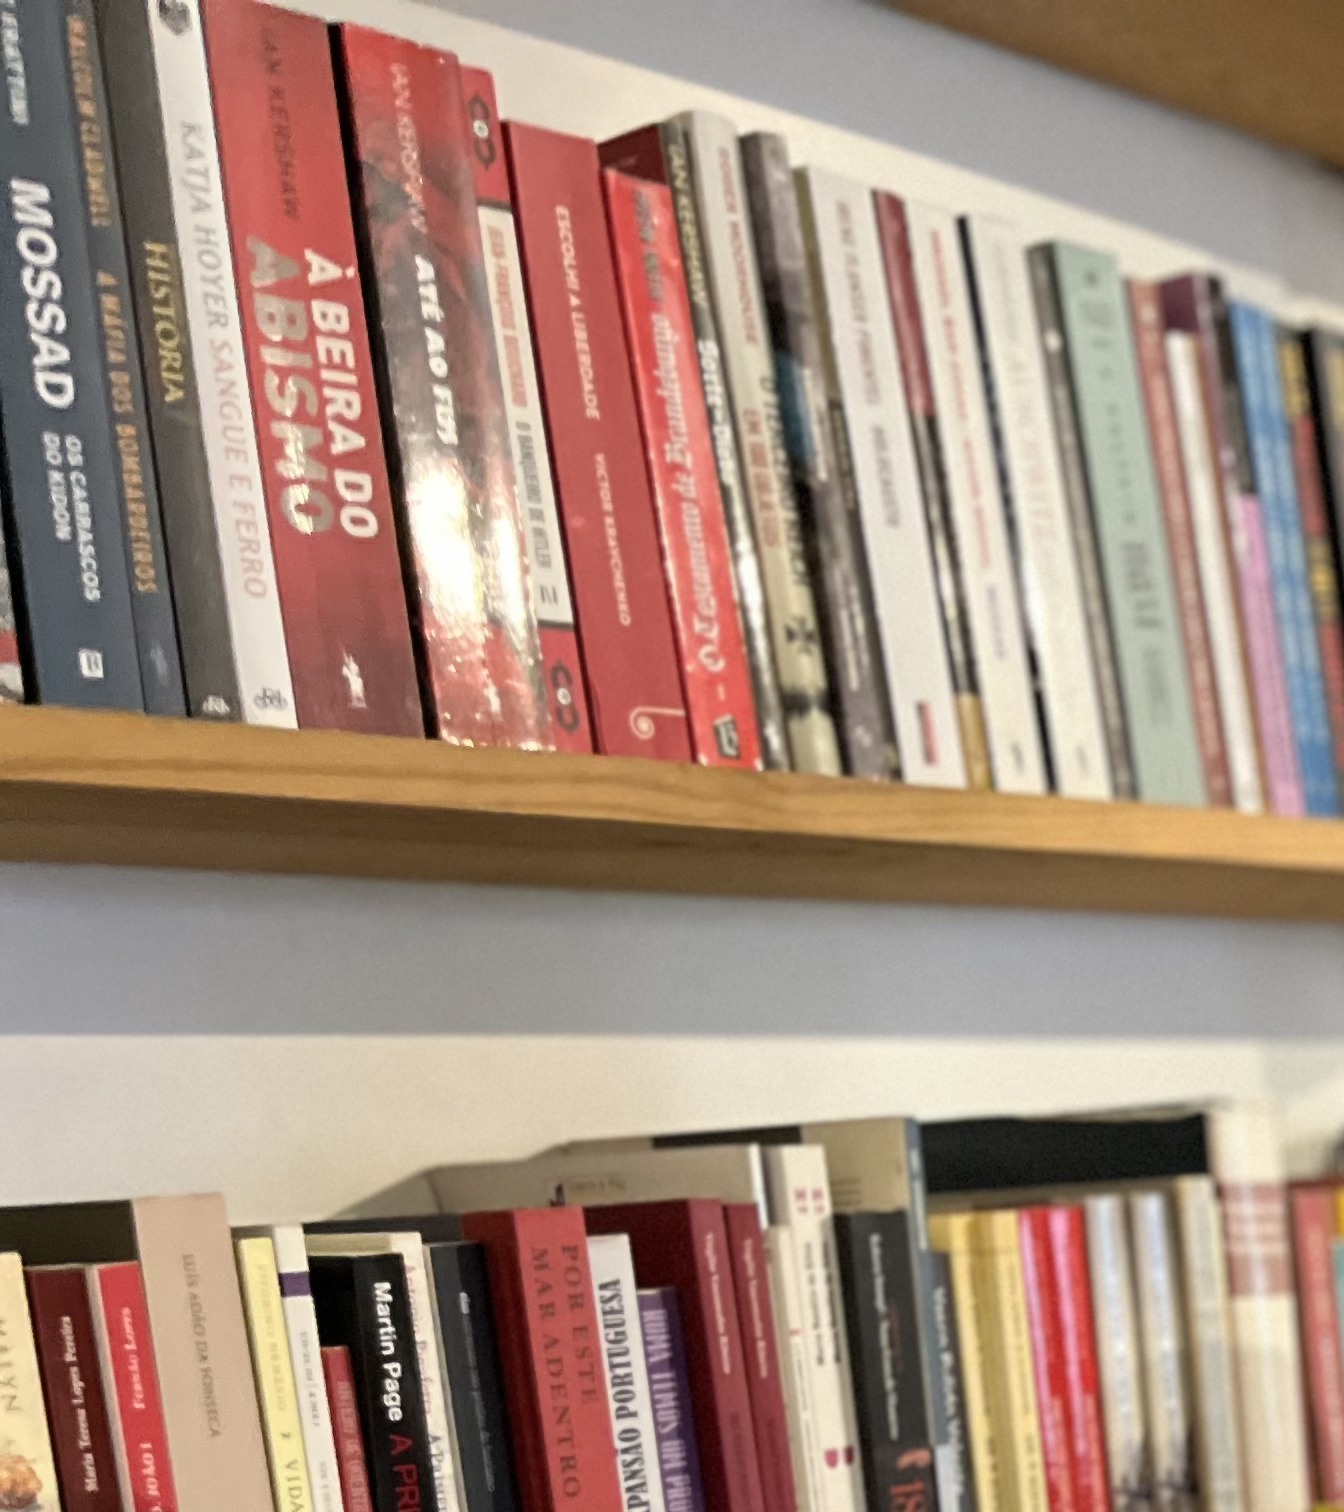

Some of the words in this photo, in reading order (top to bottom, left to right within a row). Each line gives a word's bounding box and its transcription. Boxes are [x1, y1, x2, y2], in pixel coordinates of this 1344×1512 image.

[179, 120, 214, 215] KATJA
[194, 224, 229, 330] HOYER
[303, 247, 355, 286] À
[555, 204, 578, 291] ESCOLHI
[11, 177, 75, 410] MOSSAD
[416, 254, 441, 323] ATÉ
[568, 291, 581, 307] A
[98, 269, 119, 287] A
[109, 370, 134, 413] DOS
[426, 327, 447, 378] AO
[571, 310, 599, 421] LIBERDADE
[210, 335, 248, 464] SANGUE
[245, 233, 335, 536] ABISMO
[309, 299, 367, 456] BEIRA
[43, 431, 63, 466] DO
[65, 434, 84, 467] OS
[48, 470, 72, 541] KIDON
[228, 477, 247, 492] E
[334, 468, 379, 539] DO
[670, 470, 698, 500] de
[69, 470, 101, 602] CARRASCOS
[232, 502, 267, 599] FERRO
[593, 451, 612, 514] VICTOR
[604, 514, 631, 627] KRAVCHENKO
[681, 503, 719, 648] Testamento
[698, 645, 725, 673] O
[531, 1246, 556, 1318] MAR
[562, 1242, 584, 1310] POR
[59, 1315, 77, 1362] Pereira
[121, 1307, 138, 1351] Lopes
[196, 1339, 209, 1362] DA
[372, 1278, 397, 1353] Martin
[598, 1278, 637, 1420] PORTUGUESA
[68, 1365, 85, 1404] Lopes
[378, 1359, 404, 1421] Page
[572, 1324, 598, 1404] ESTE
[76, 1408, 92, 1451] Teresa
[388, 1430, 411, 1453] A
[543, 1332, 580, 1499] ADENTRO
[83, 1452, 98, 1493] Maria
[141, 1453, 160, 1497] JOÃO
